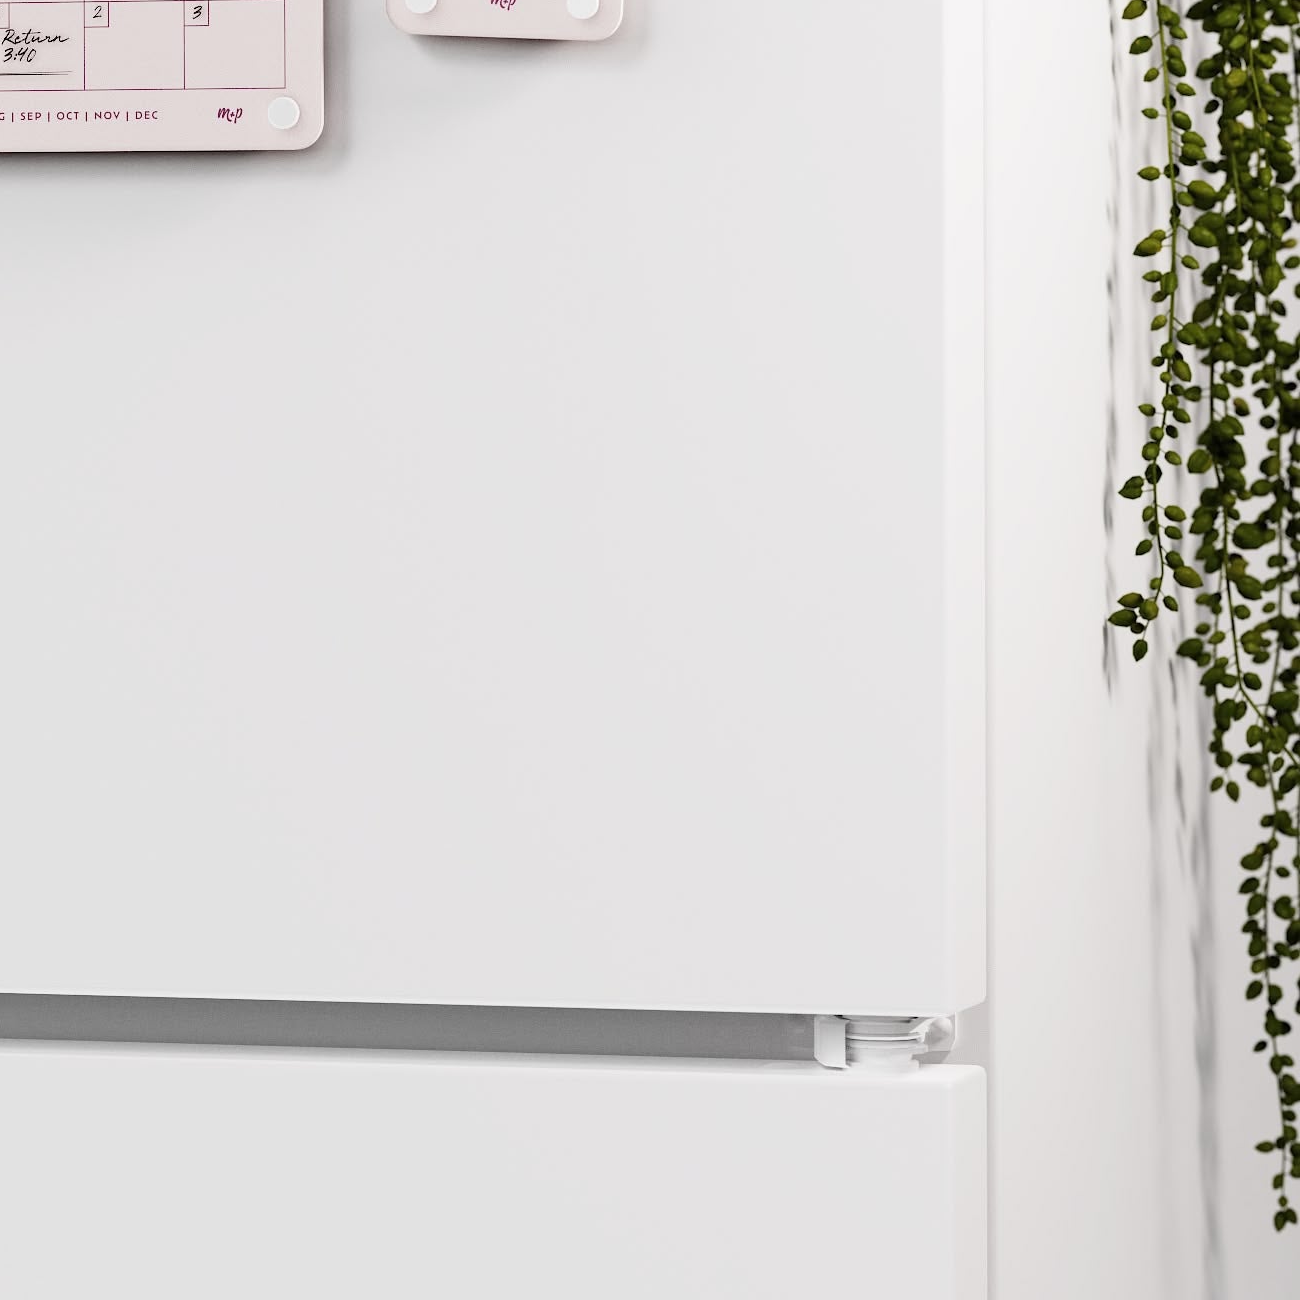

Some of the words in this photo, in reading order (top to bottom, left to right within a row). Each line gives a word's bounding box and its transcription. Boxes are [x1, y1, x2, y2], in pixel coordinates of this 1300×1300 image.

[93, 6, 102, 18] 2
[193, 6, 202, 19] 3
[1, 28, 70, 46] Return
[4, 47, 36, 63] 3:40
[20, 112, 42, 121] SEP
[57, 111, 79, 120] OCT
[94, 111, 120, 120] NOV
[135, 110, 158, 120] DEC
